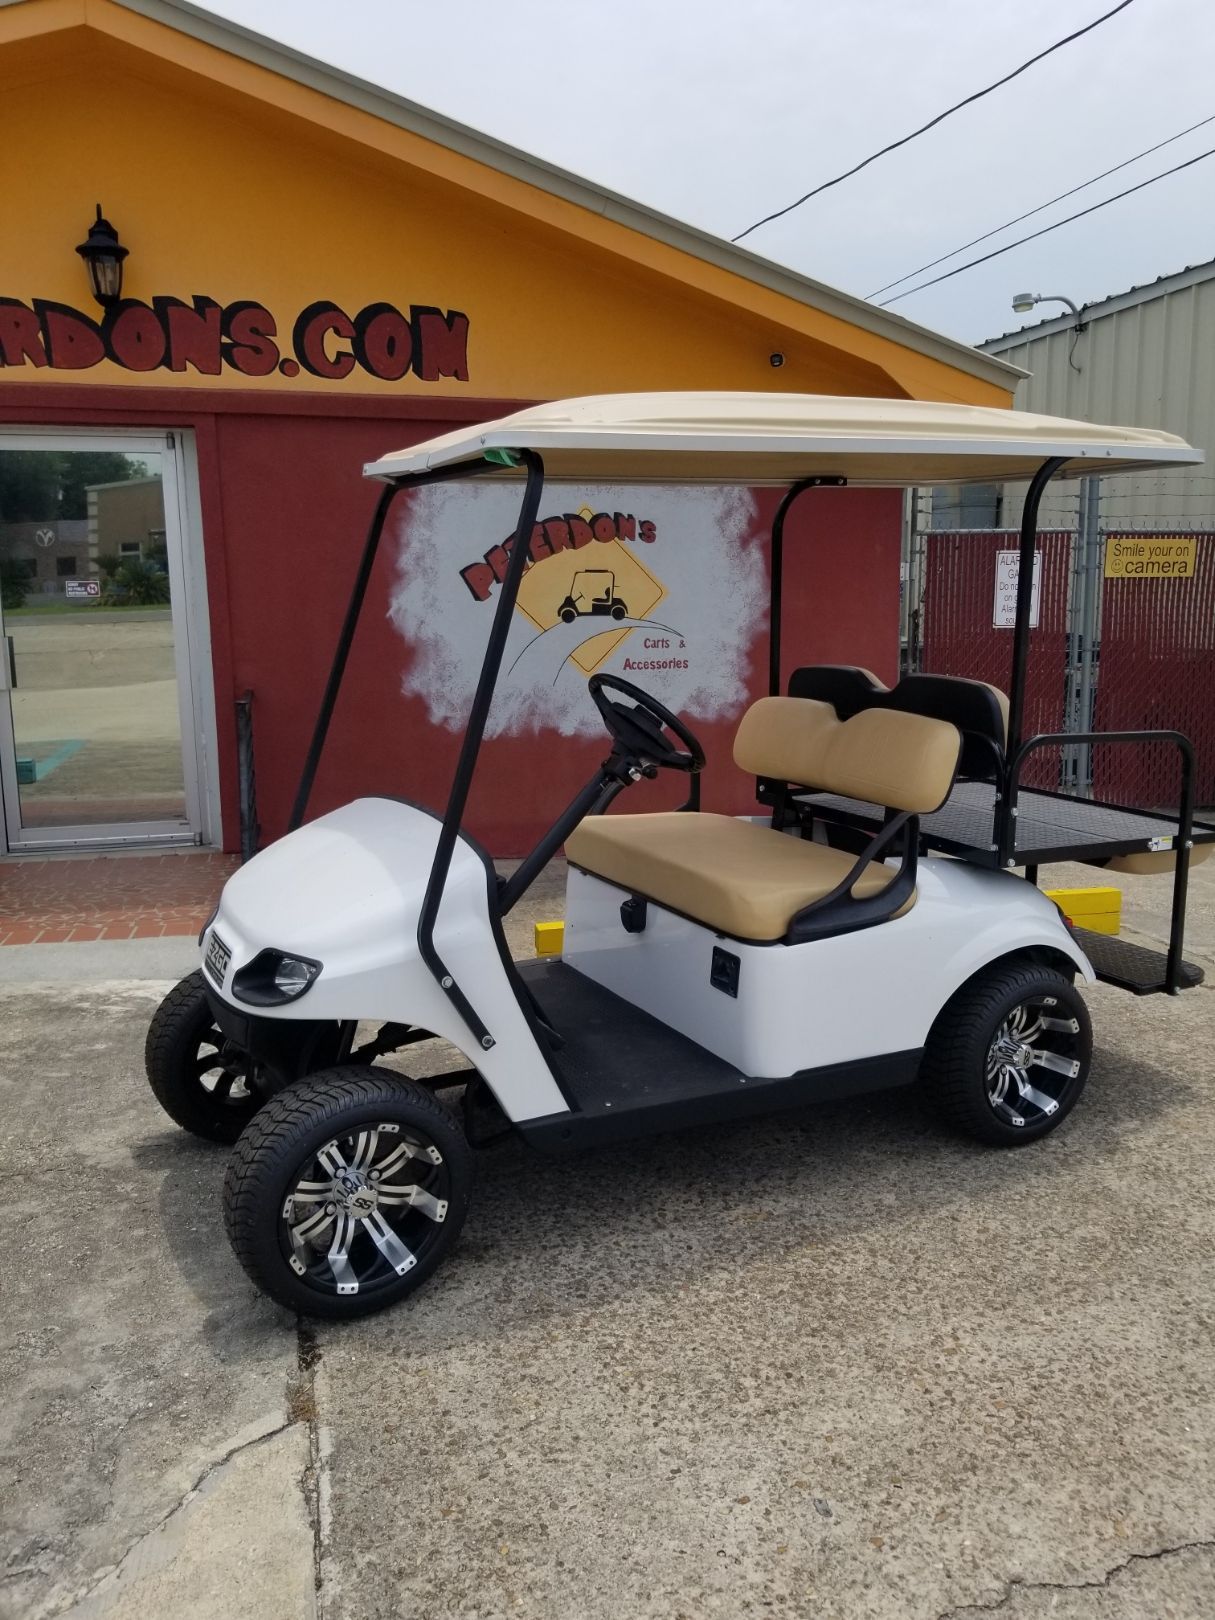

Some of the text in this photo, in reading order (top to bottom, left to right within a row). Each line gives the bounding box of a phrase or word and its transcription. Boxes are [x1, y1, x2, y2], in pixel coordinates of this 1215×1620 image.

[1113, 543, 1189, 560] Smile your on
[1125, 560, 1188, 574] camera
[644, 637, 687, 649] Carts &
[623, 657, 689, 670] Accessories
